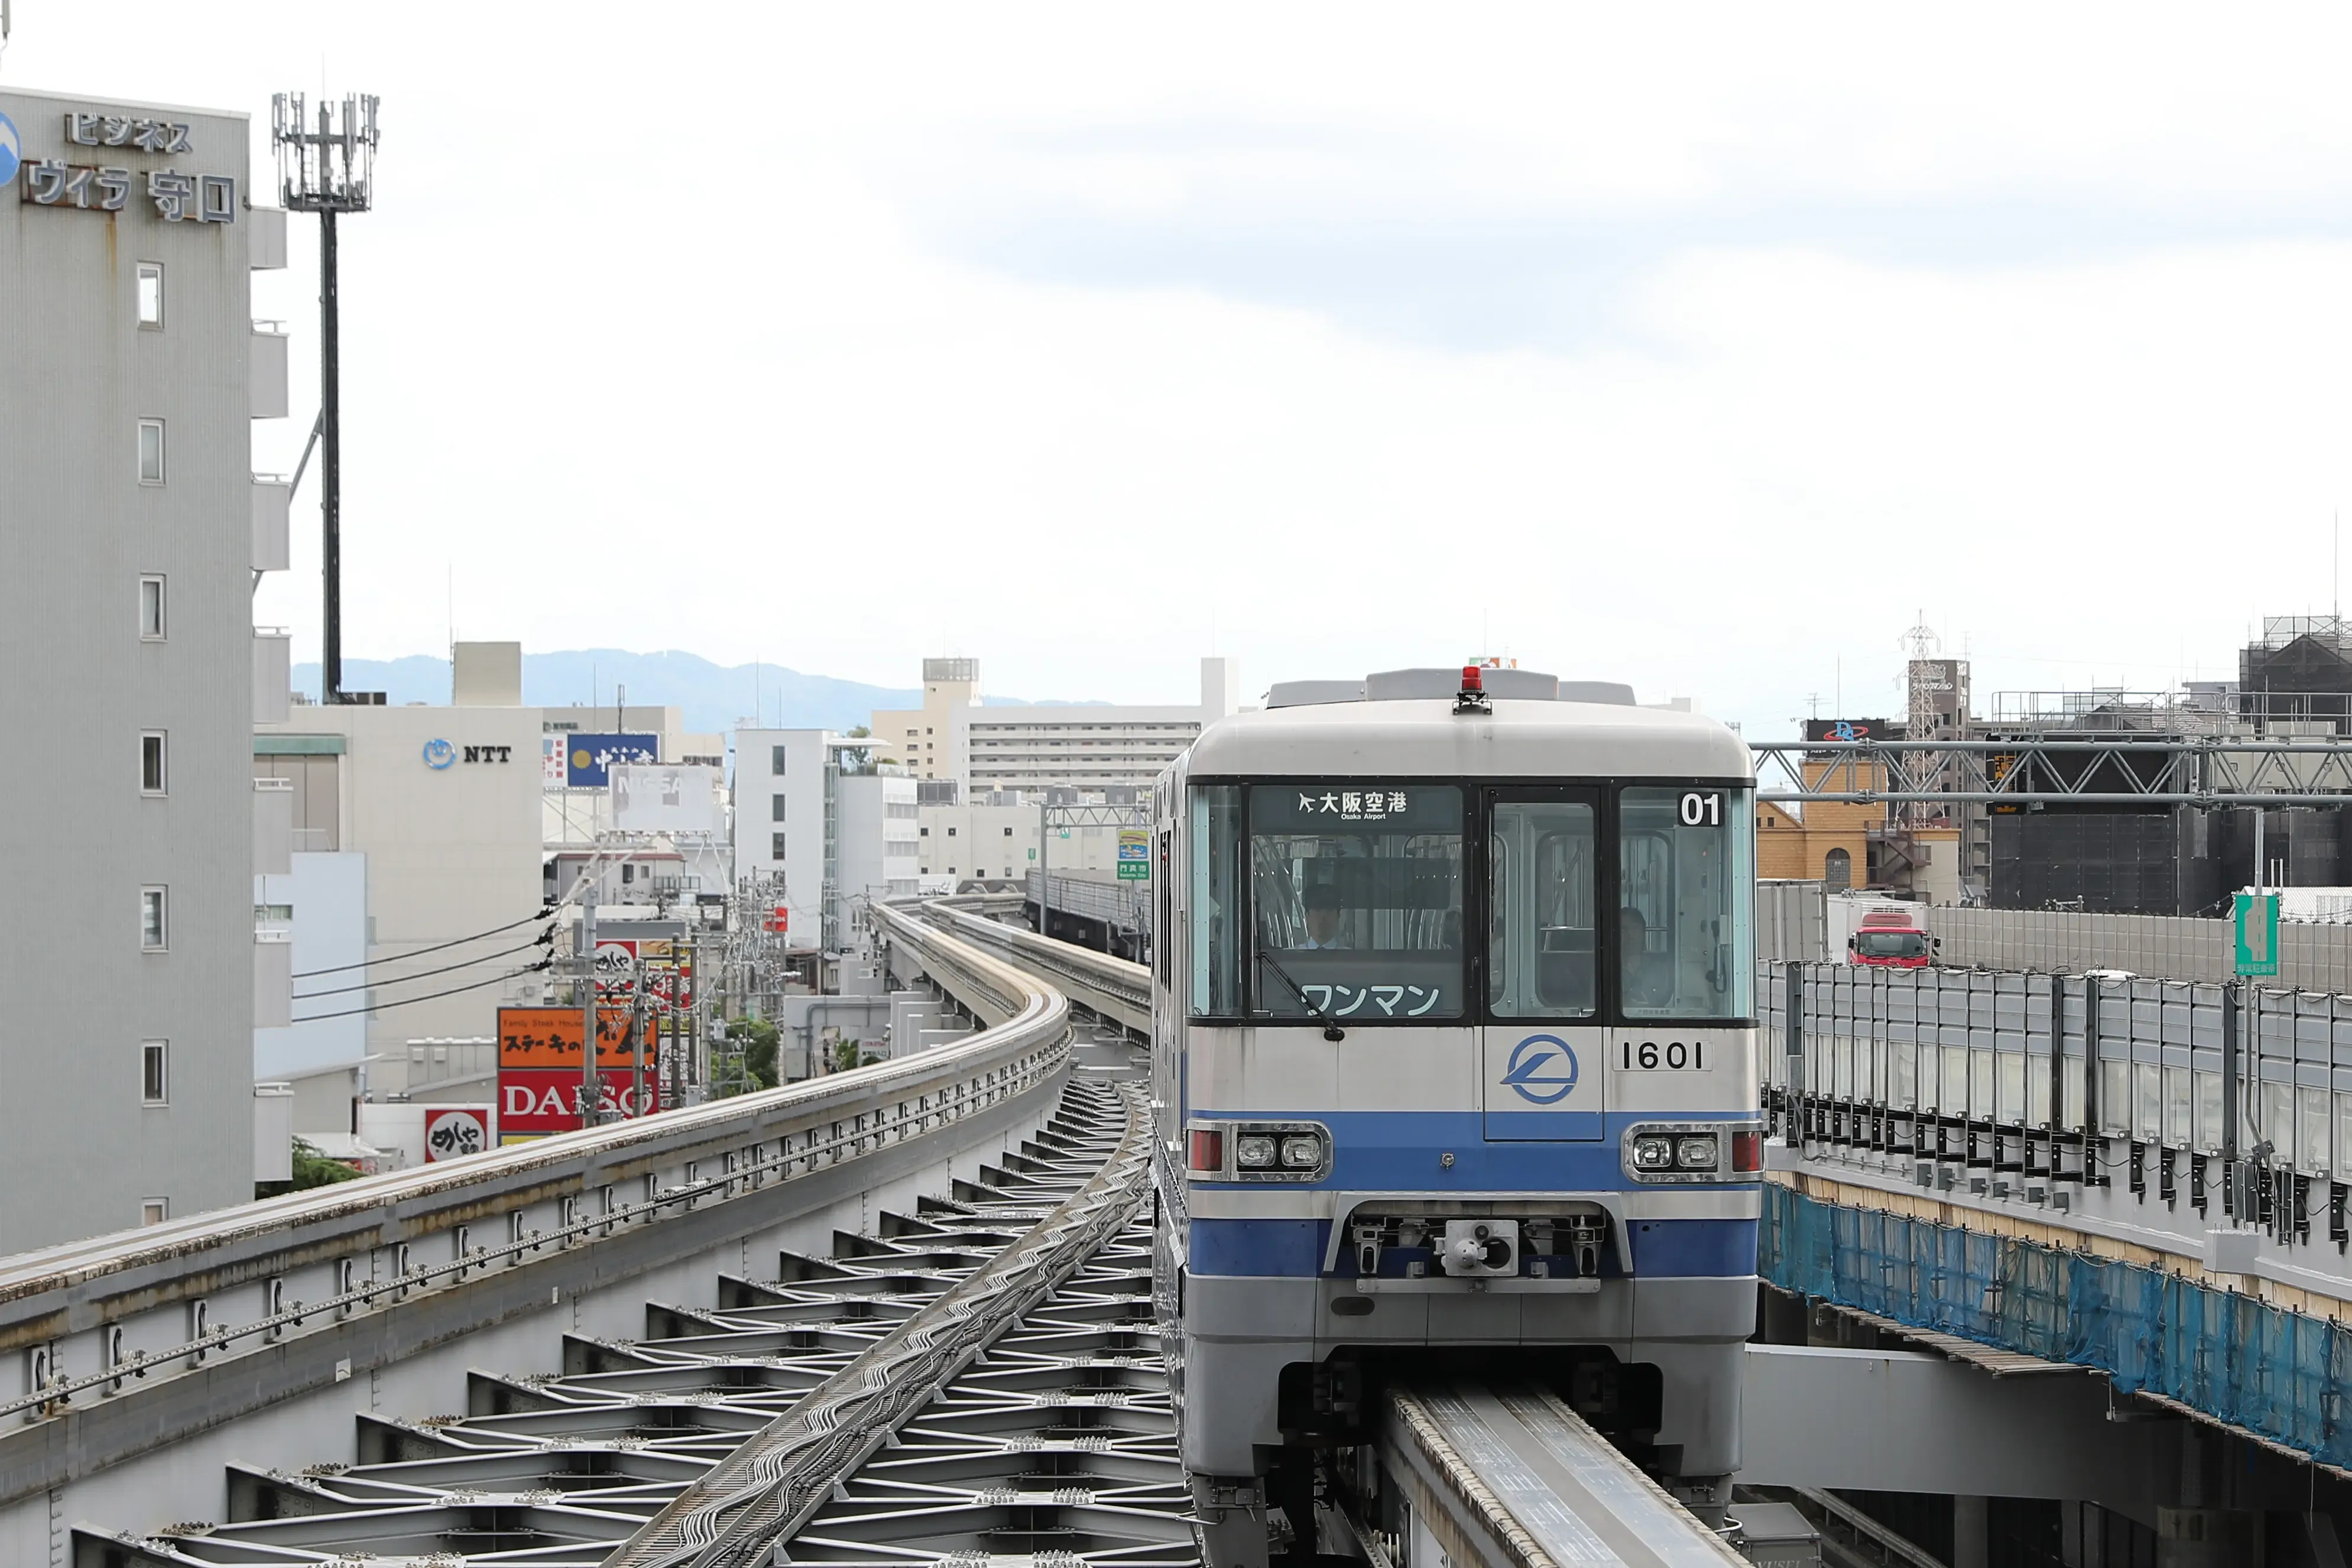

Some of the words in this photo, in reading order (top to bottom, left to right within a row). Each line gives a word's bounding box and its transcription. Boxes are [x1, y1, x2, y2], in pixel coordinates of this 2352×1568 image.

[72, 112, 194, 154] ビジネス
[148, 167, 235, 225] 守口
[464, 746, 512, 763] NTT
[595, 748, 654, 772] 中寺
[1319, 791, 1407, 813] 大阪空港
[1681, 793, 1719, 826] 01
[1302, 985, 1439, 1016] ワンマン
[504, 1020, 527, 1028] Family
[1624, 1042, 1702, 1069] 1601
[504, 1086, 653, 1116] DASO
